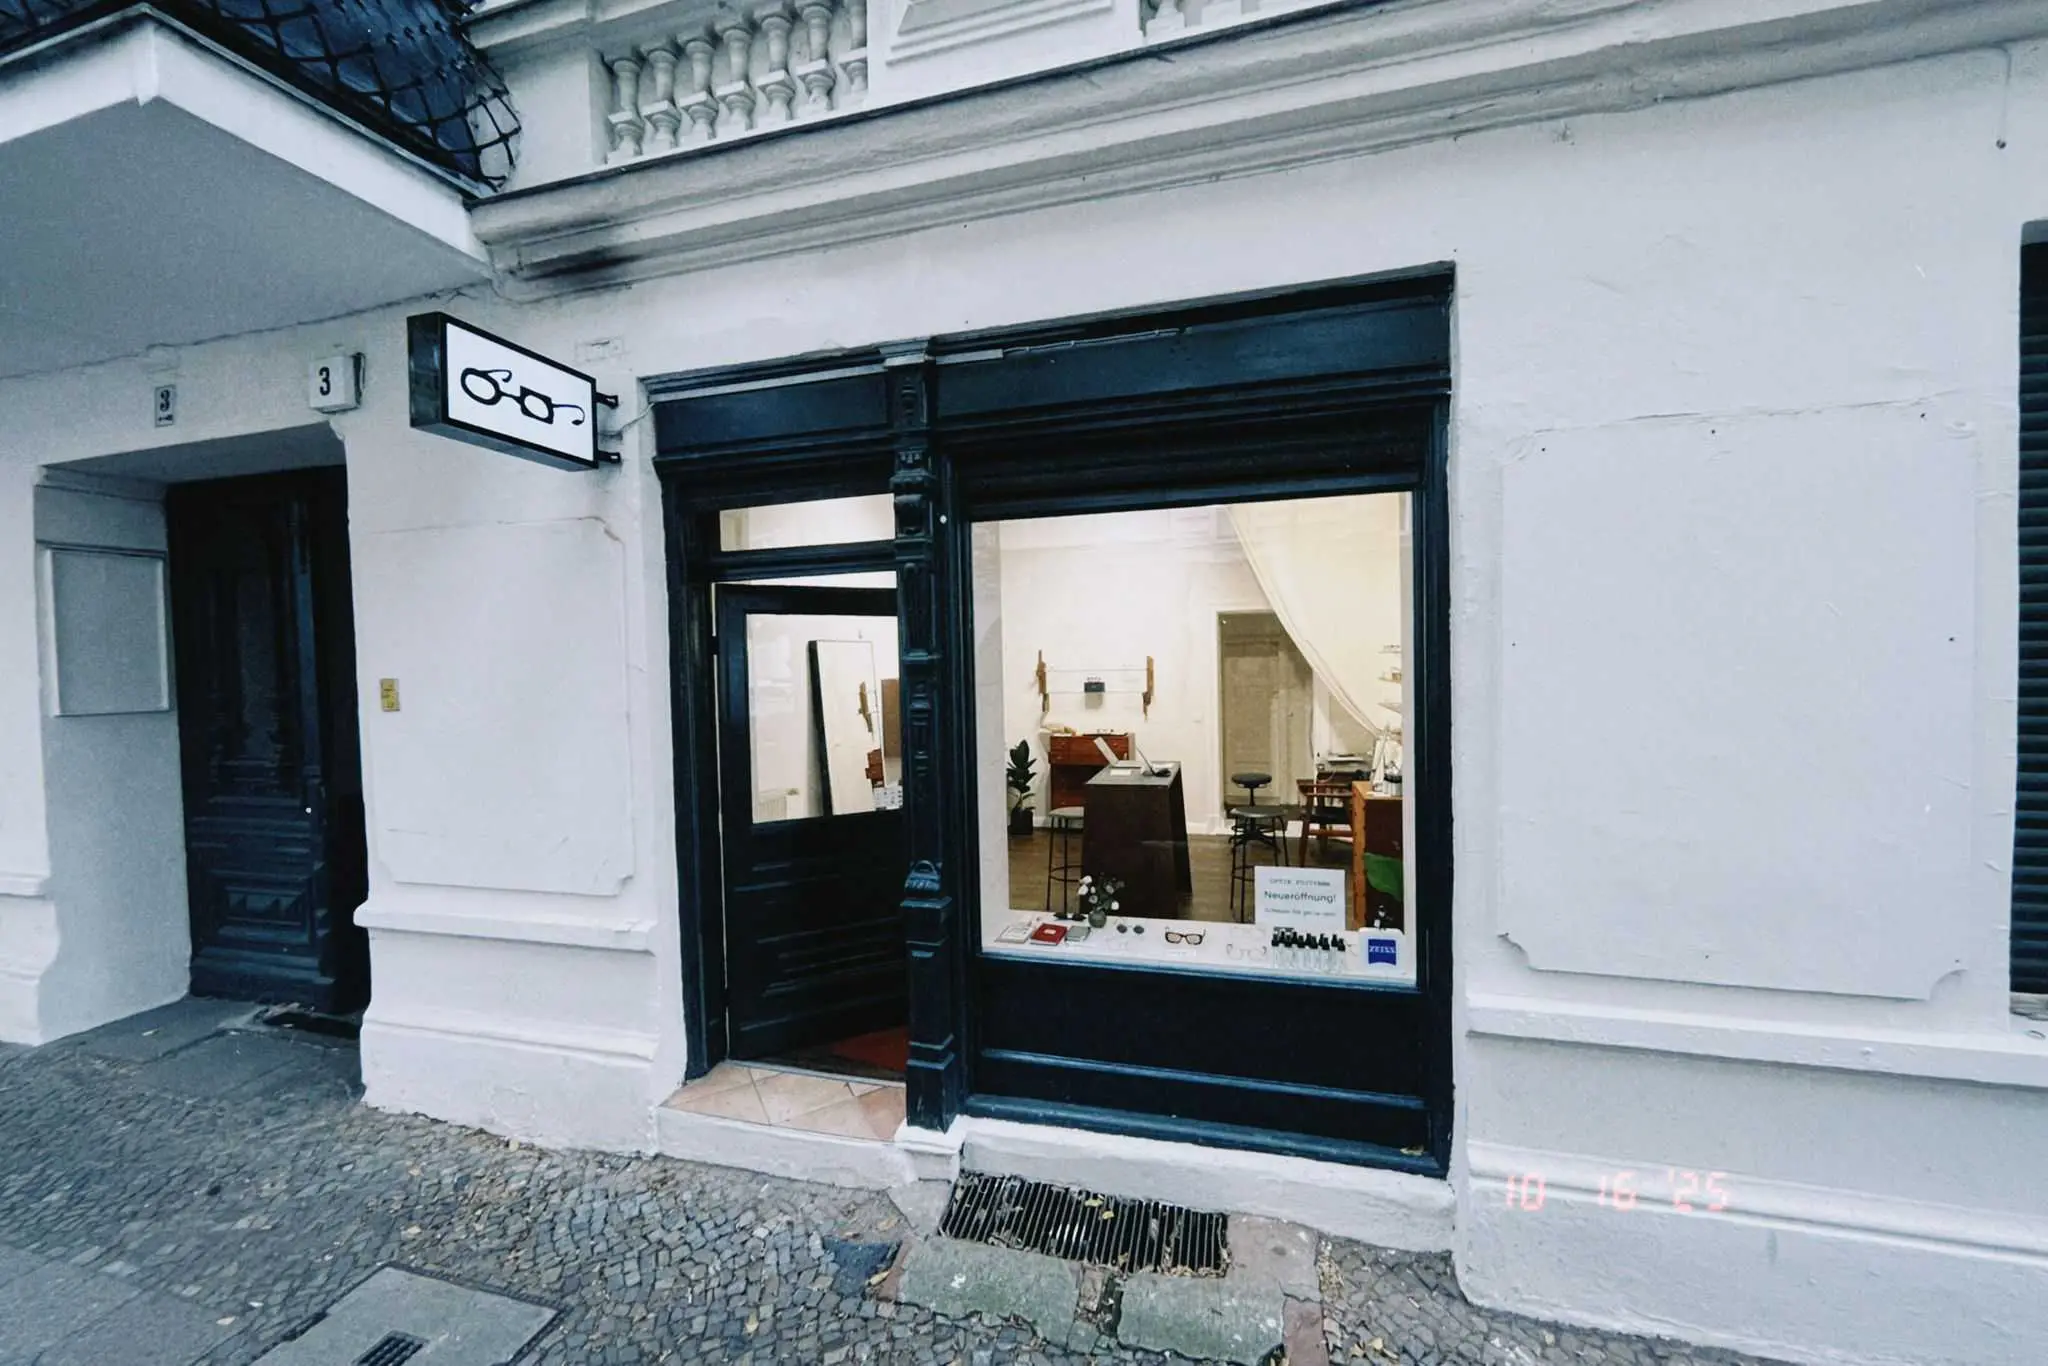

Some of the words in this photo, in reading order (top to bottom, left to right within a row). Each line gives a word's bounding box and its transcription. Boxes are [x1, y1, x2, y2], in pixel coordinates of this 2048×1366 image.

[319, 366, 331, 396] 3
[160, 389, 170, 412] 3
[1264, 890, 1336, 904] Neueröffnung!
[1369, 945, 1395, 953] ZEISS
